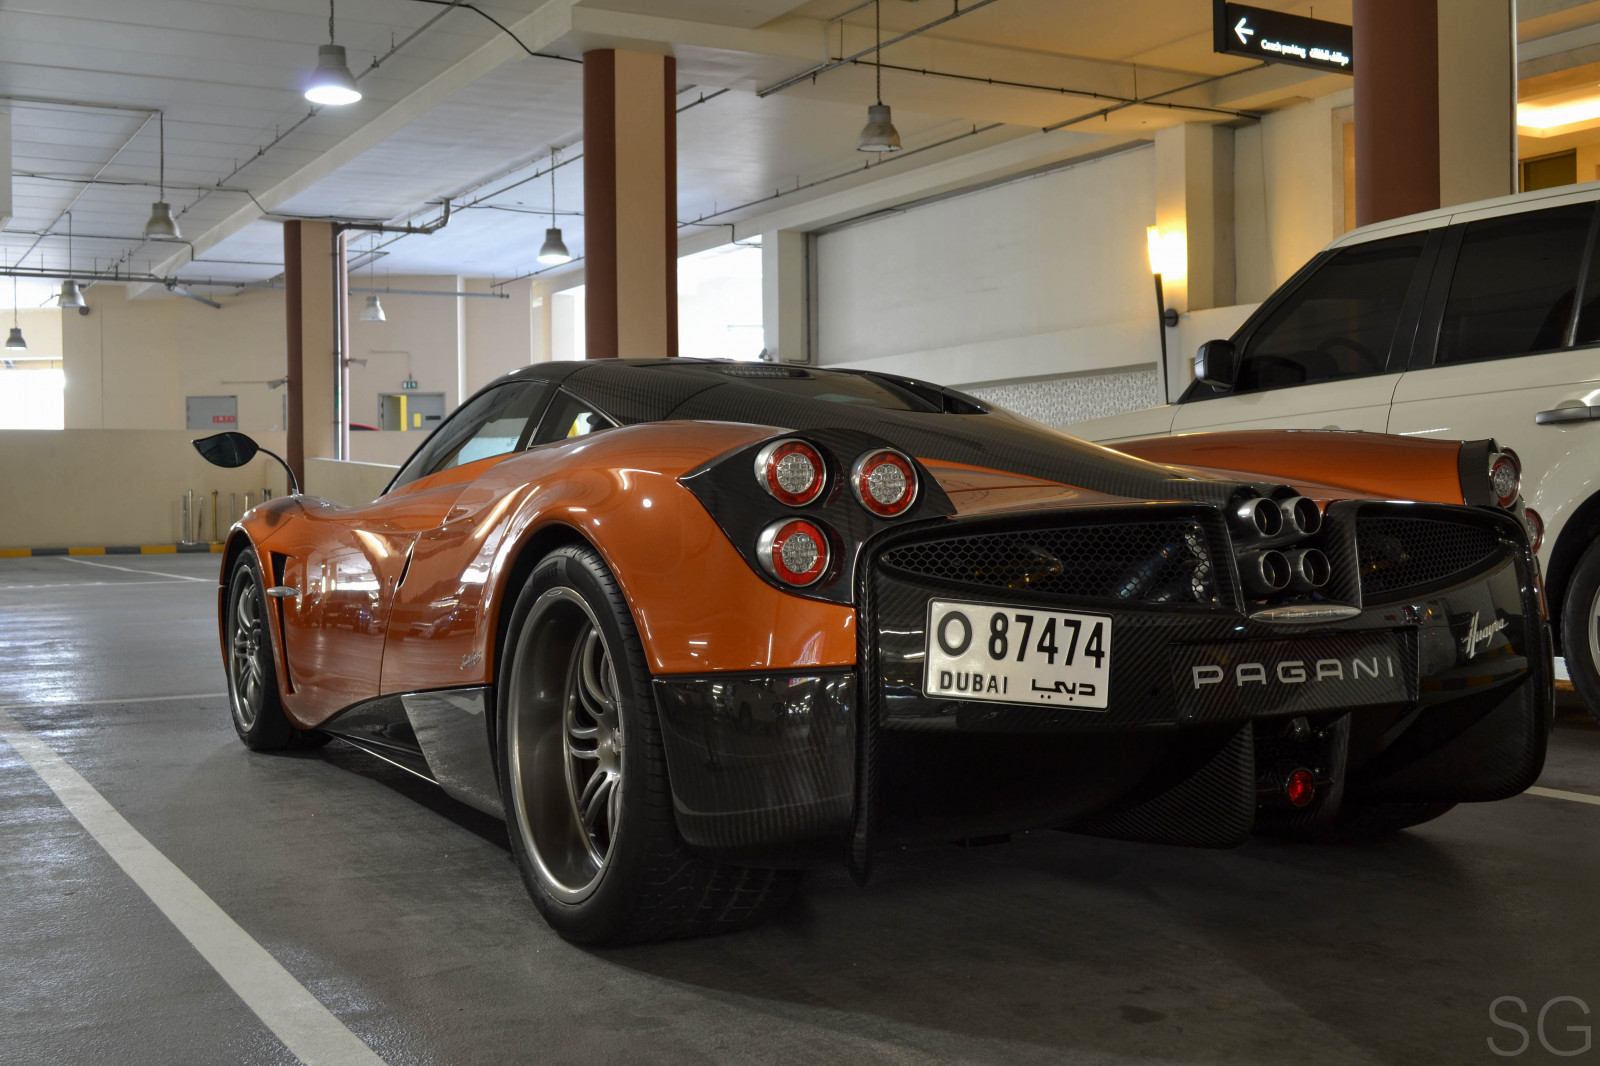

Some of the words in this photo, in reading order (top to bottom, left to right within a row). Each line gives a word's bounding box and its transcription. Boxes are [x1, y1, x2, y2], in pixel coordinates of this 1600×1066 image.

[988, 612, 1105, 669] 87474
[1460, 610, 1509, 659] Huayra
[939, 670, 1008, 694] DUBAI
[1031, 678, 1096, 701] دبي
[1192, 656, 1395, 690] PAGANI
